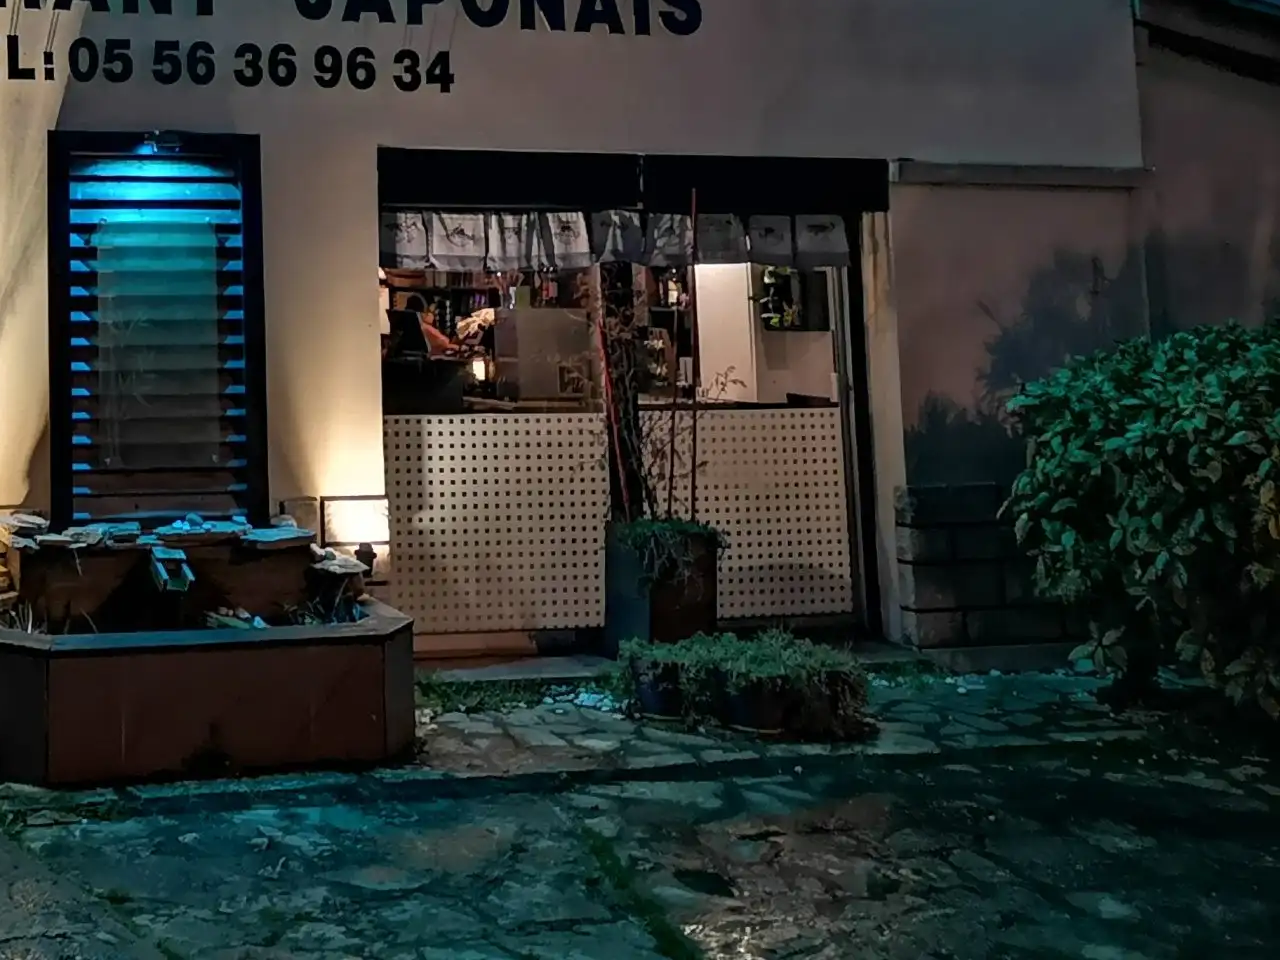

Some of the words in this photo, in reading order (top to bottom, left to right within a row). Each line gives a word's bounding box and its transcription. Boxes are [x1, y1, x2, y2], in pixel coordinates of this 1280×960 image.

[68, 36, 134, 84] 05
[151, 39, 216, 86] 56
[233, 42, 297, 89] 36
[313, 45, 376, 90] 96
[392, 48, 456, 93] 34
